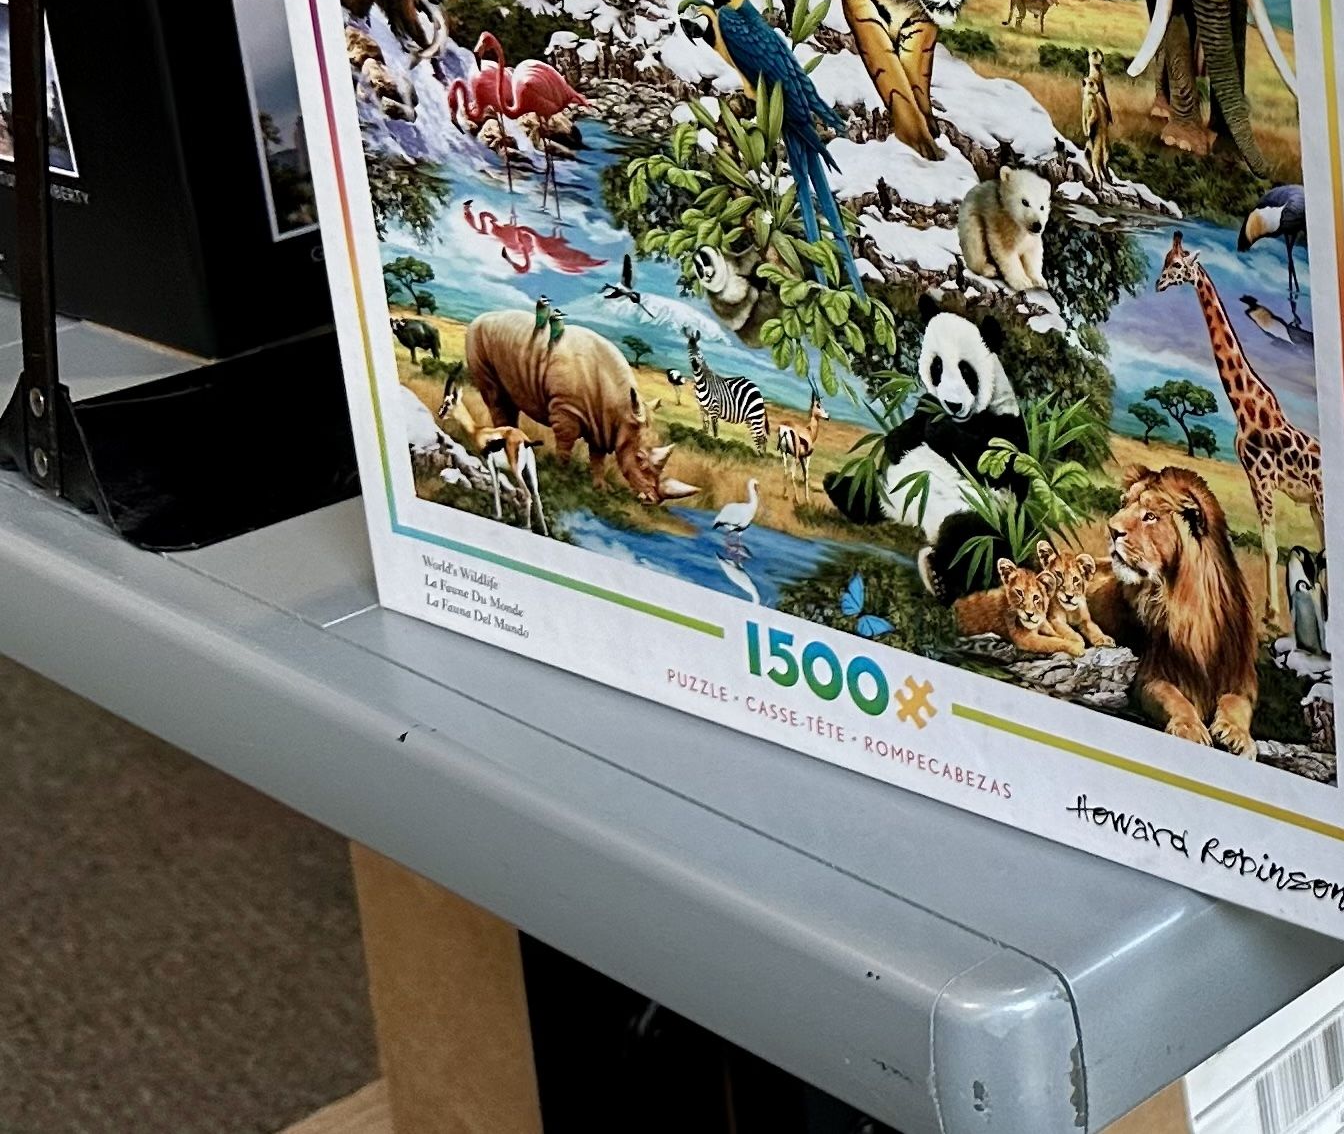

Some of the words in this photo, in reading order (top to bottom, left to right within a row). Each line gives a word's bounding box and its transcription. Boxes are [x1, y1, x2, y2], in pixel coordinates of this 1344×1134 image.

[422, 554, 458, 576] World's
[460, 566, 499, 590] Wildlife
[425, 574, 438, 588] La
[440, 579, 469, 598] Faune
[472, 589, 487, 604] Du
[490, 595, 524, 617] Monde
[426, 593, 439, 607] La
[442, 598, 471, 618] Fauna
[474, 609, 491, 625] Del
[494, 615, 529, 638] Mundo
[746, 620, 890, 716] 1500
[667, 668, 728, 703] PUZZLE
[746, 695, 845, 743] CASSE-TÊTE
[865, 735, 1013, 800] ROMPECABEZAS
[1067, 791, 1189, 859] Howard
